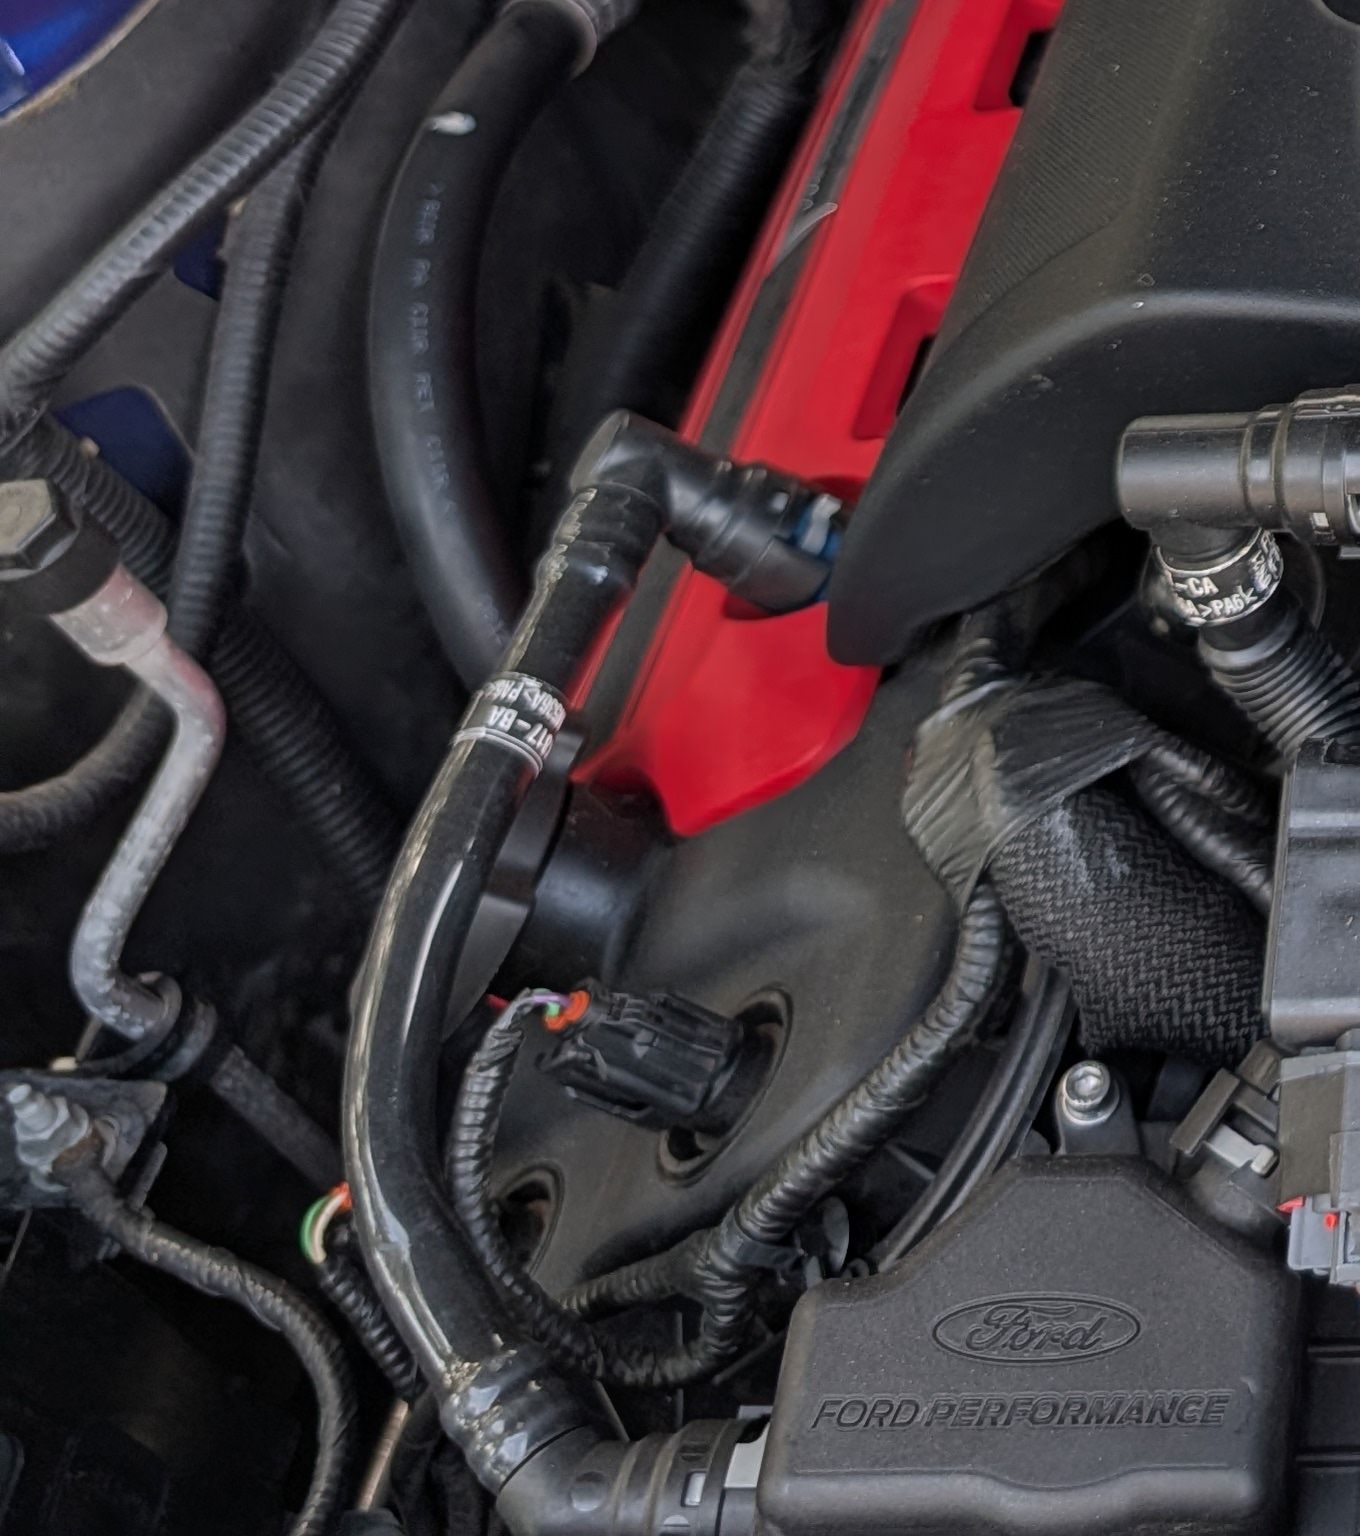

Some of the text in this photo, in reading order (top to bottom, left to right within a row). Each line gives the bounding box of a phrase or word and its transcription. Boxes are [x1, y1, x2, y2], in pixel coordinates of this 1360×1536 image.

[965, 1302, 1109, 1353] Ford
[809, 1389, 1237, 1432] FORD PERFORMANCE
